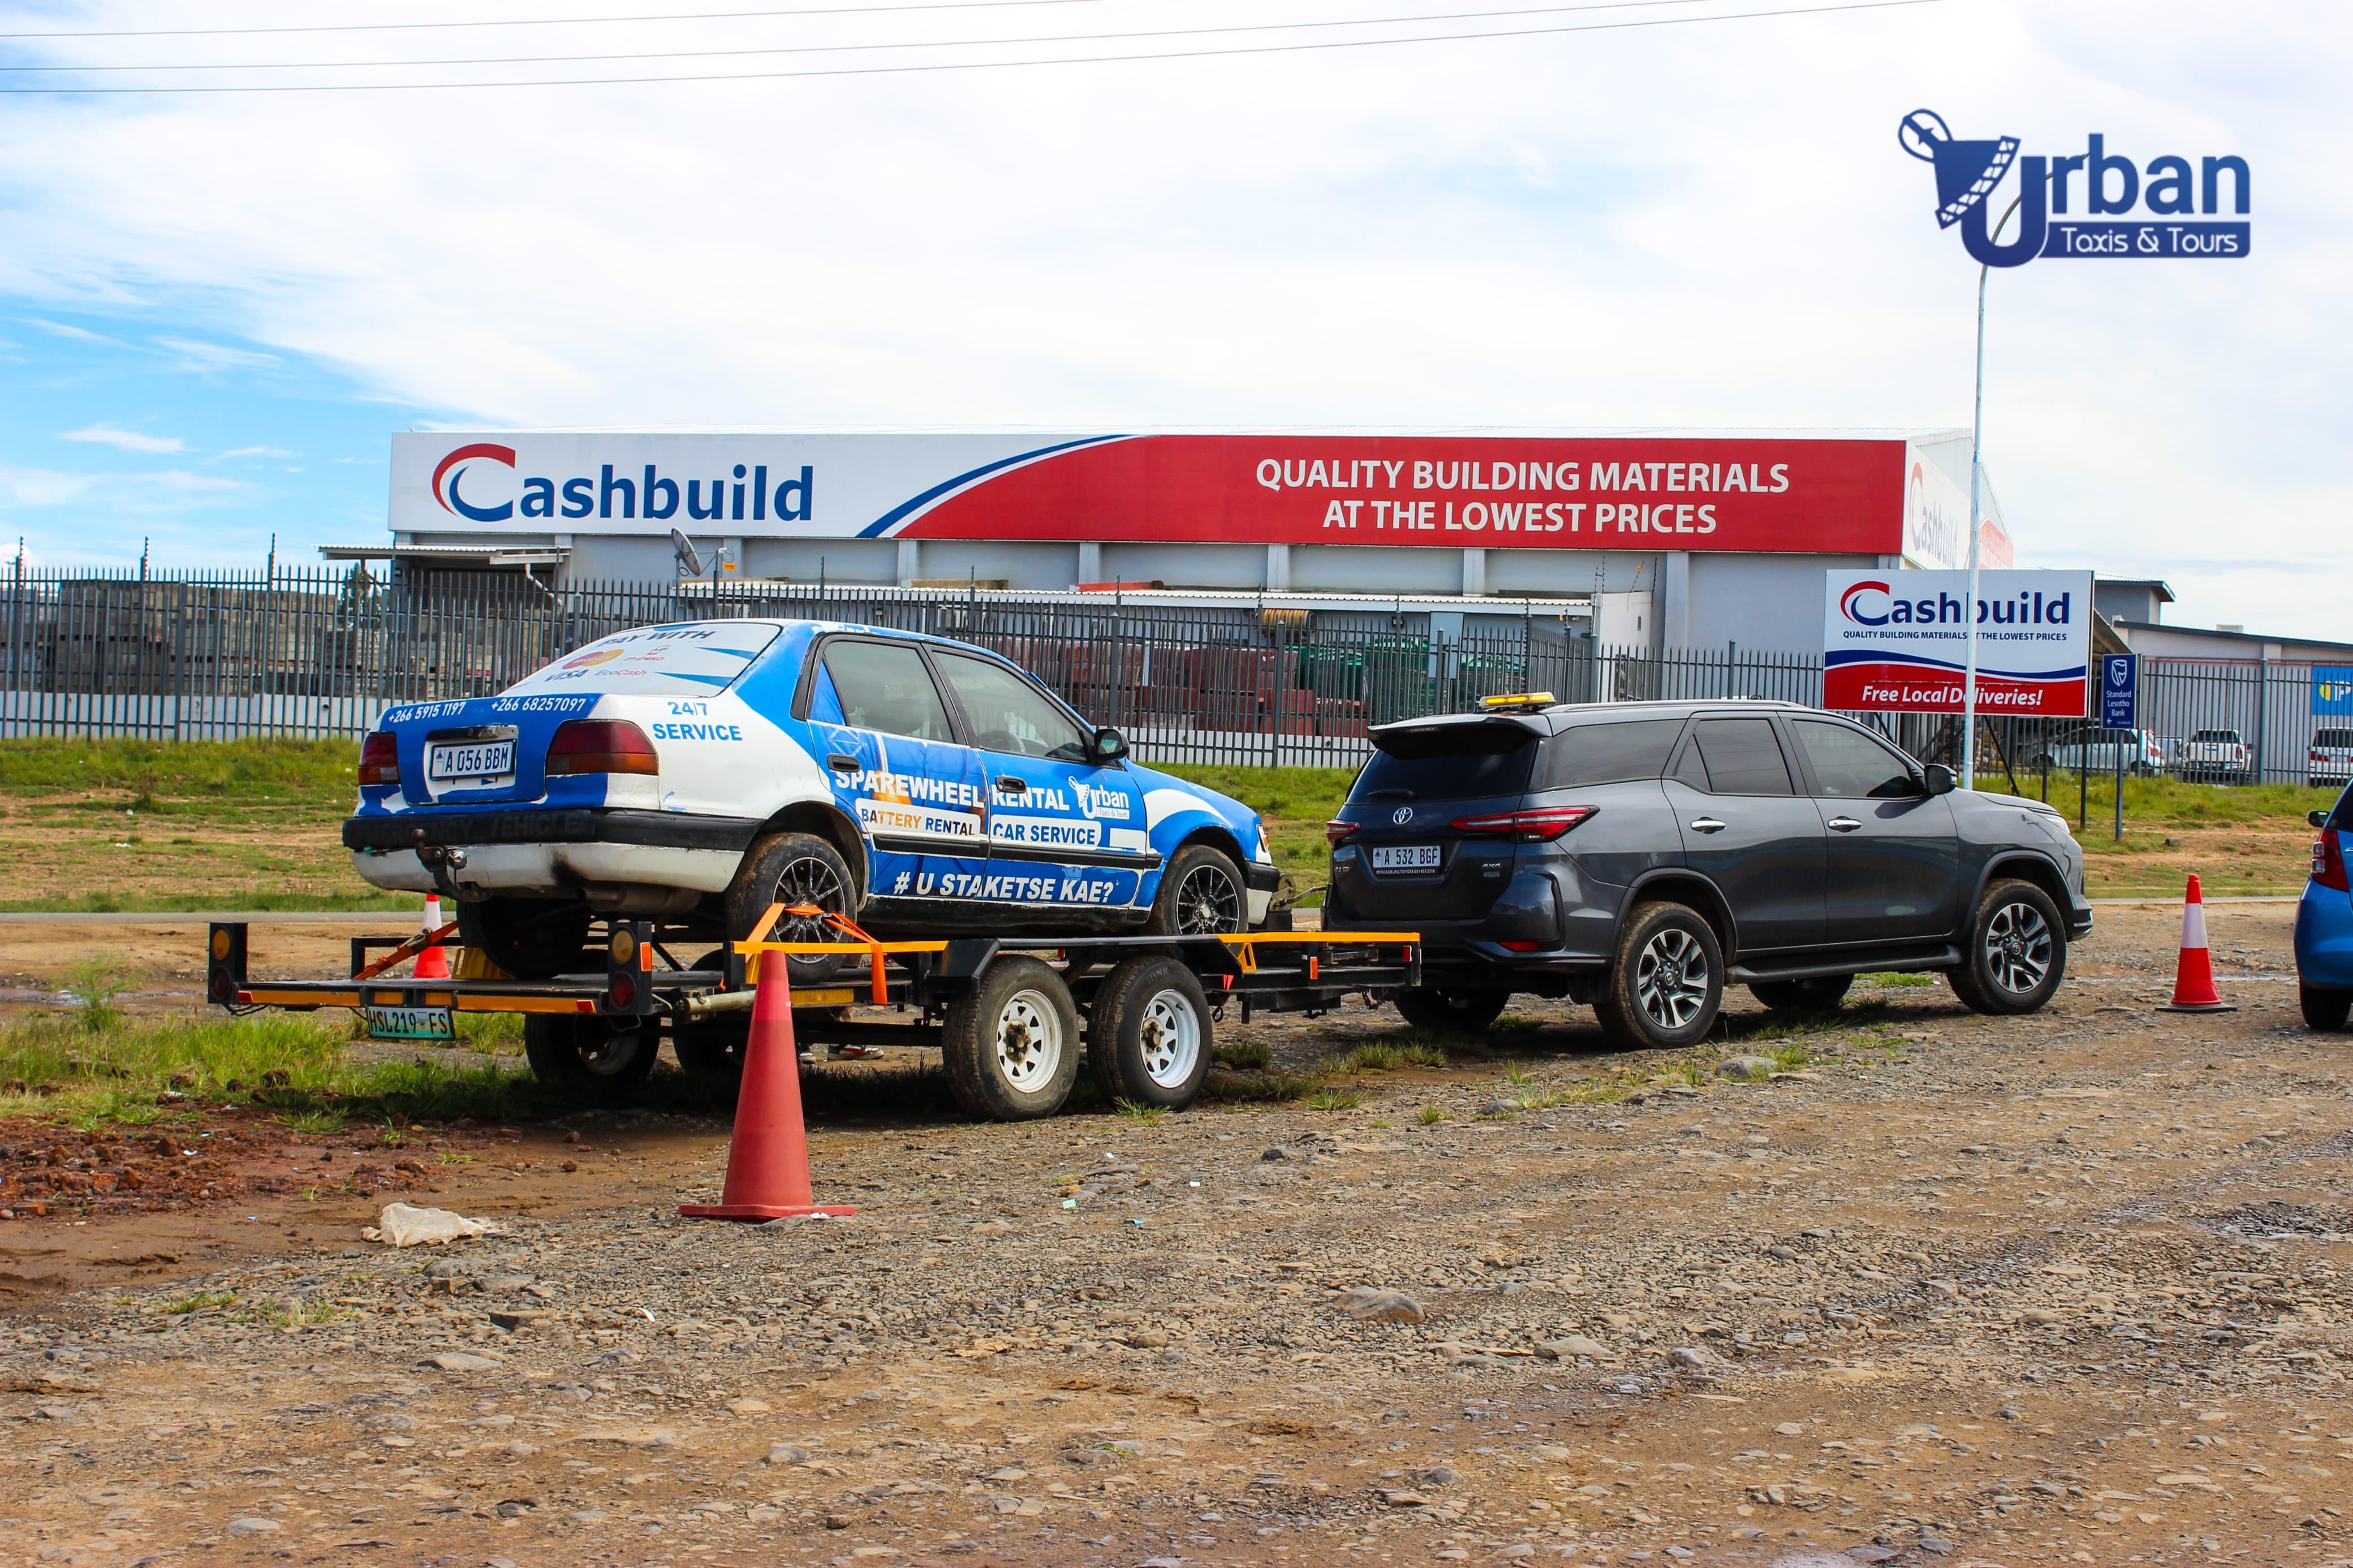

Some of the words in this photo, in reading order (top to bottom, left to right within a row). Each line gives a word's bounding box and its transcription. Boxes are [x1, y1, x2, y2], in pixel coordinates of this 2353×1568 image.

[432, 443, 813, 522] Cashbuild
[1255, 459, 1403, 493] QUALITY
[1413, 461, 1579, 491] BUILDING
[1590, 463, 1789, 493] MATERIALS
[1322, 500, 1364, 528] AT
[1371, 502, 1435, 529] THE
[1445, 502, 1586, 532] LOWEST
[1596, 504, 1716, 534] PRICES
[597, 634, 646, 647] PAY
[647, 630, 716, 640] WITH
[1843, 631, 1878, 640] QUALITY
[1880, 631, 1919, 640] BUILDING
[1999, 632, 2035, 641] LOWEST
[2036, 633, 2067, 641] PRICES
[544, 669, 590, 681] VISA
[492, 698, 519, 711] +266
[522, 698, 586, 711] 68257097
[1862, 685, 1898, 702] Free
[1902, 686, 1948, 703] Local
[1949, 687, 2043, 706] Dliveries!
[389, 709, 412, 723] +266
[415, 705, 440, 719] 5915
[442, 702, 466, 716] 1197
[667, 701, 708, 715] 24/7
[653, 723, 743, 741] SERVICE
[445, 751, 453, 772] A
[457, 749, 481, 771] 056
[485, 747, 509, 770] BBM
[835, 771, 985, 809] SPAREWHEEL
[991, 784, 1070, 811] RENTAL
[1081, 784, 1130, 819] Urban
[861, 808, 921, 829] BATTERY
[925, 818, 975, 836] RENTAL
[993, 823, 1025, 841] CAR
[1030, 826, 1096, 845] SERVICE
[1385, 849, 1390, 865] A
[1396, 849, 1413, 865] 532
[1420, 848, 1438, 865] BGF
[894, 871, 910, 895] #
[917, 872, 935, 895] U
[940, 874, 1055, 901] STAKETSE
[1059, 879, 1114, 904] KAE?
[429, 1013, 447, 1034] FS
